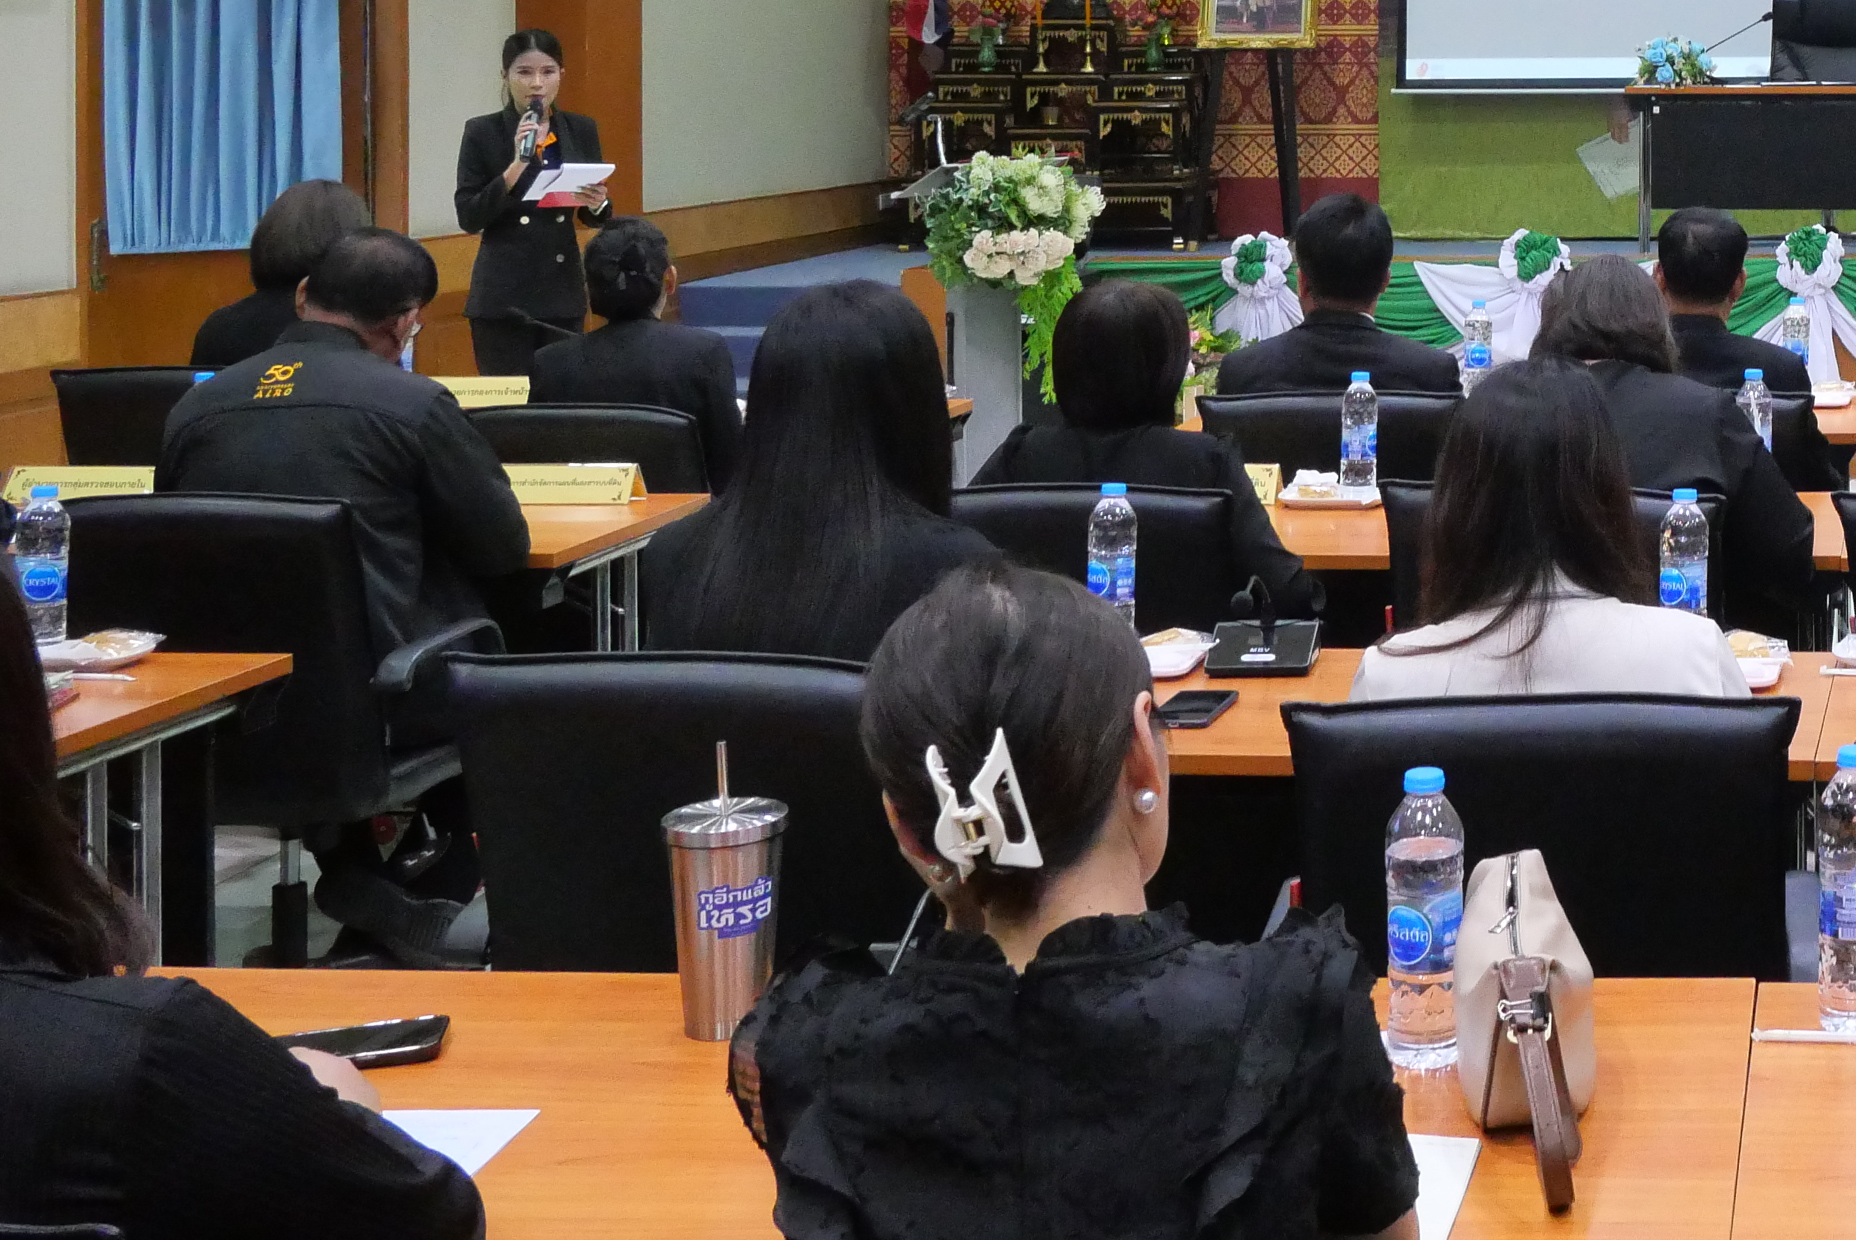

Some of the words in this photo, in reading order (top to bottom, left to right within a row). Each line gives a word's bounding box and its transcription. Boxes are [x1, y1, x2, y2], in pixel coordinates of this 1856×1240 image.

[452, 386, 530, 397] วยการกองการเจ้าหน้า
[509, 477, 622, 487] การสำนักจัดการแผนที่และสารบบที่ดิน
